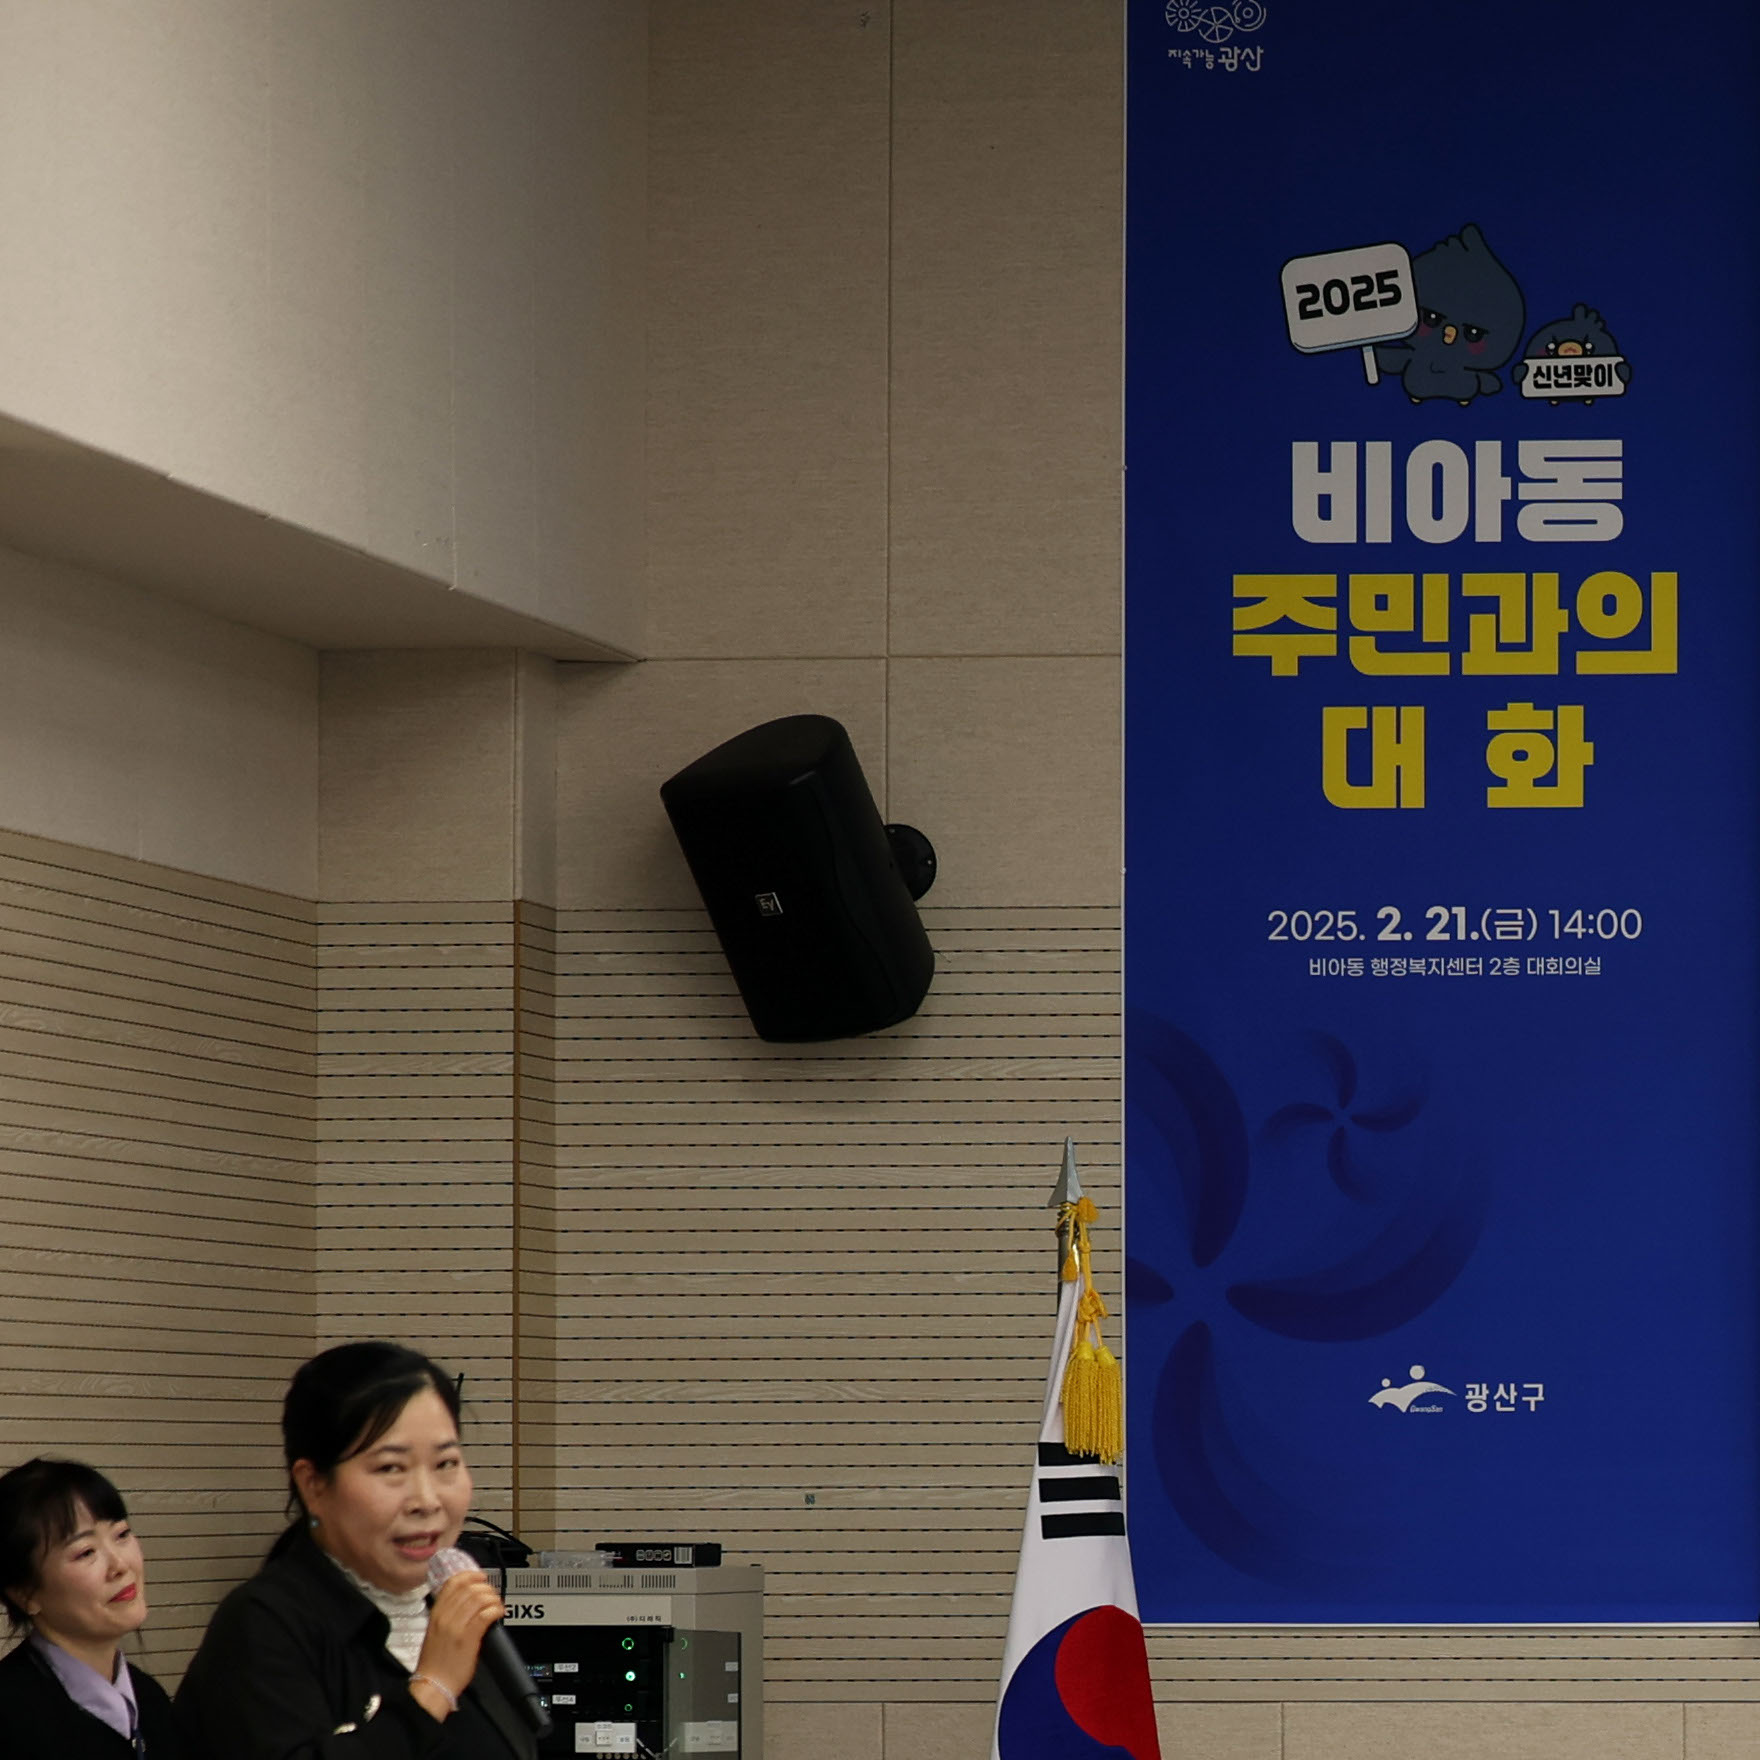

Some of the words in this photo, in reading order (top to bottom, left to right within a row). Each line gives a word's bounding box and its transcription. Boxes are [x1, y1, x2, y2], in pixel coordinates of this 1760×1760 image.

[1167, 49, 1215, 70] 지속가능
[1217, 46, 1264, 72] 광산
[1295, 269, 1402, 321] 2025
[1532, 362, 1615, 390] 신년맞이
[1292, 439, 1624, 544] 비아동
[1232, 571, 1678, 676] 주민과의
[1267, 910, 1367, 941] 2025.
[1376, 906, 1413, 941] 2.
[1425, 906, 1539, 942] 21.(금)
[1549, 908, 1643, 940] 14:00
[1308, 957, 1365, 977] 비아동
[1370, 957, 1483, 977] 행정복지센터
[1489, 956, 1521, 976] 2층
[1527, 956, 1601, 976] 대회의실
[1464, 1382, 1545, 1413] 광산구
